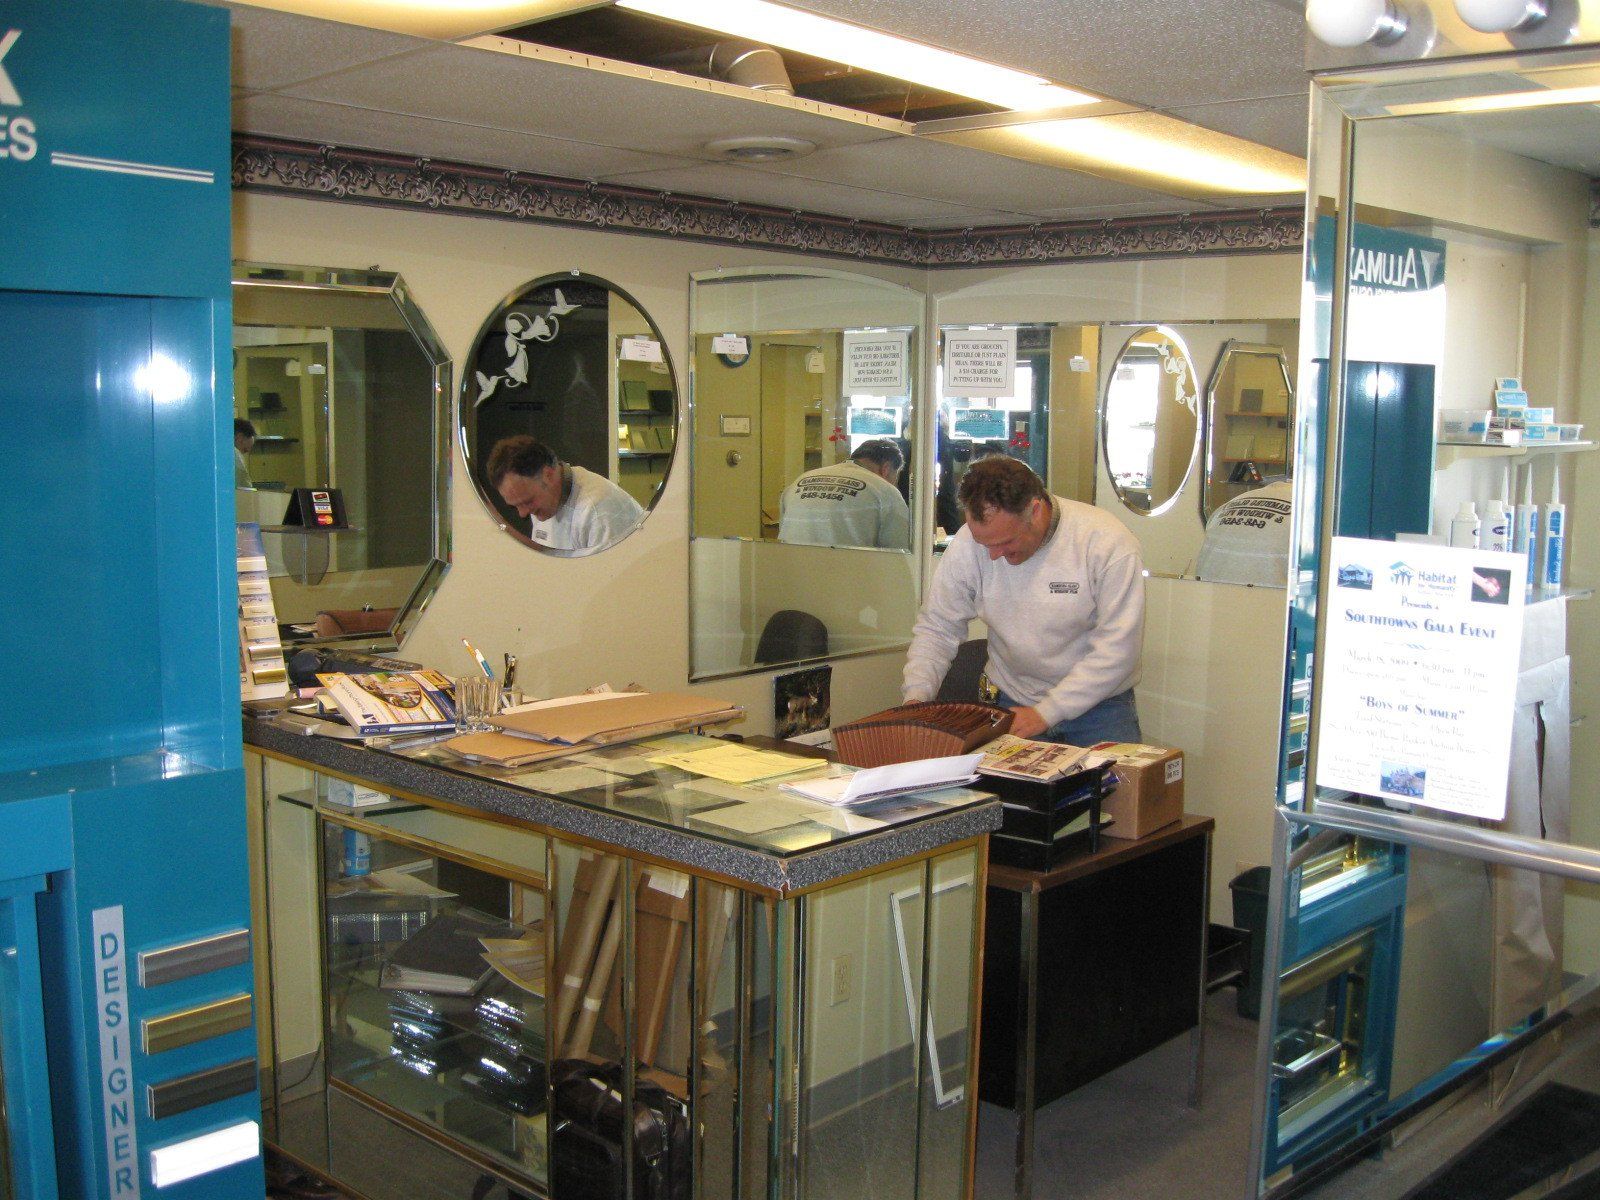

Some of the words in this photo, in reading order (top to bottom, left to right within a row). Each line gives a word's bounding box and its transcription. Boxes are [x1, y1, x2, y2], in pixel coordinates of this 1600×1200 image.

[837, 478, 861, 487] GLASS
[836, 487, 858, 496] FILM
[1417, 570, 1457, 585] Habitat
[1423, 619, 1454, 634] GALA
[1460, 622, 1497, 639] EVENT
[100, 932, 135, 1194] DESIGNER
